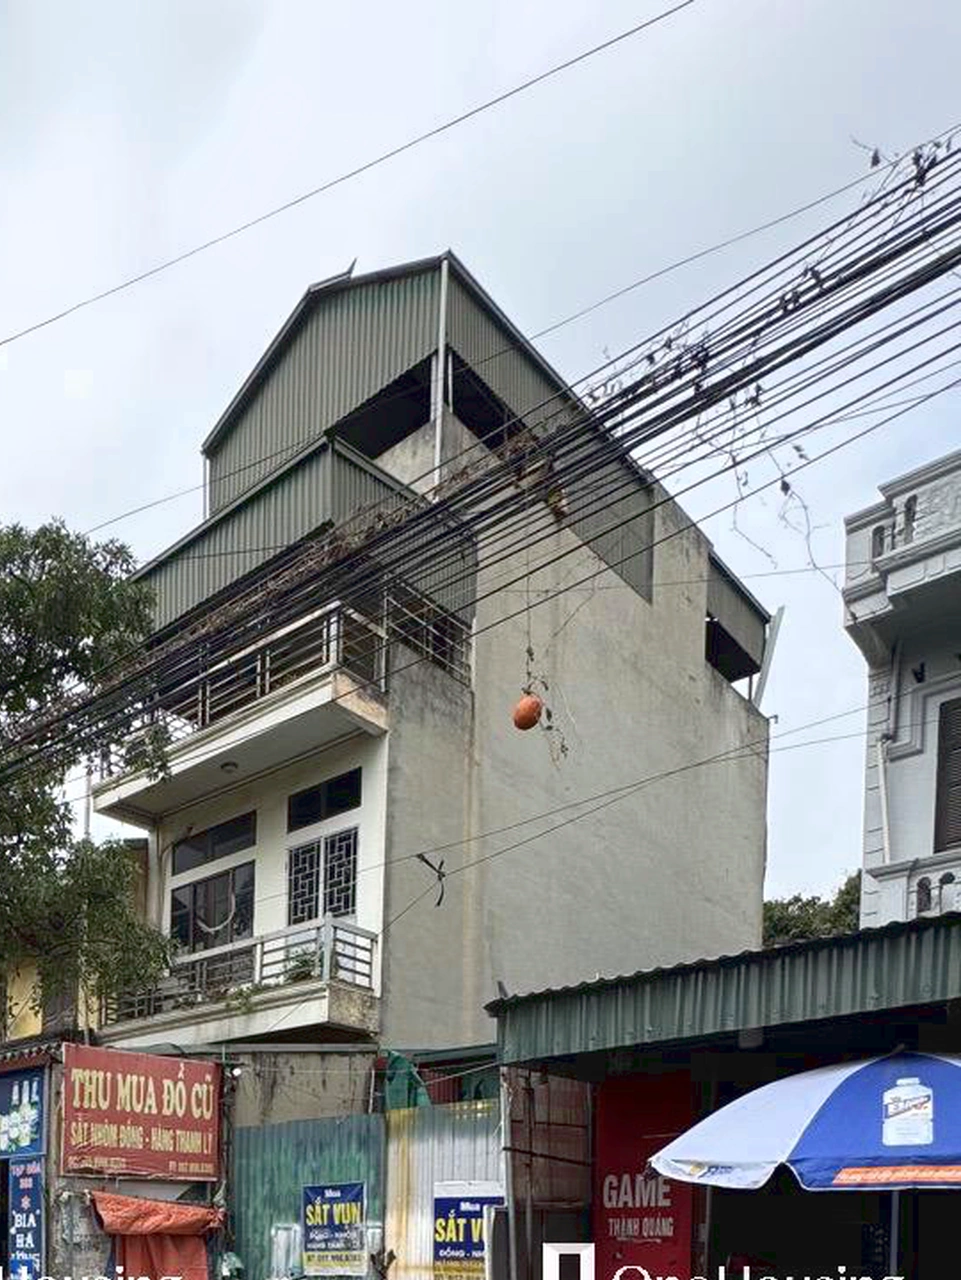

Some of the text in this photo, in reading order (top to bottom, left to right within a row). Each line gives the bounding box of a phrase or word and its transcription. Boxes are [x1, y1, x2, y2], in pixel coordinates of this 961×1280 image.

[71, 1068, 113, 1111] THU
[116, 1073, 158, 1115] MUA
[191, 1074, 214, 1120] CŨ
[603, 1173, 672, 1209] GAME
[306, 1196, 331, 1226] SẮT
[435, 1209, 467, 1243] SẮT
